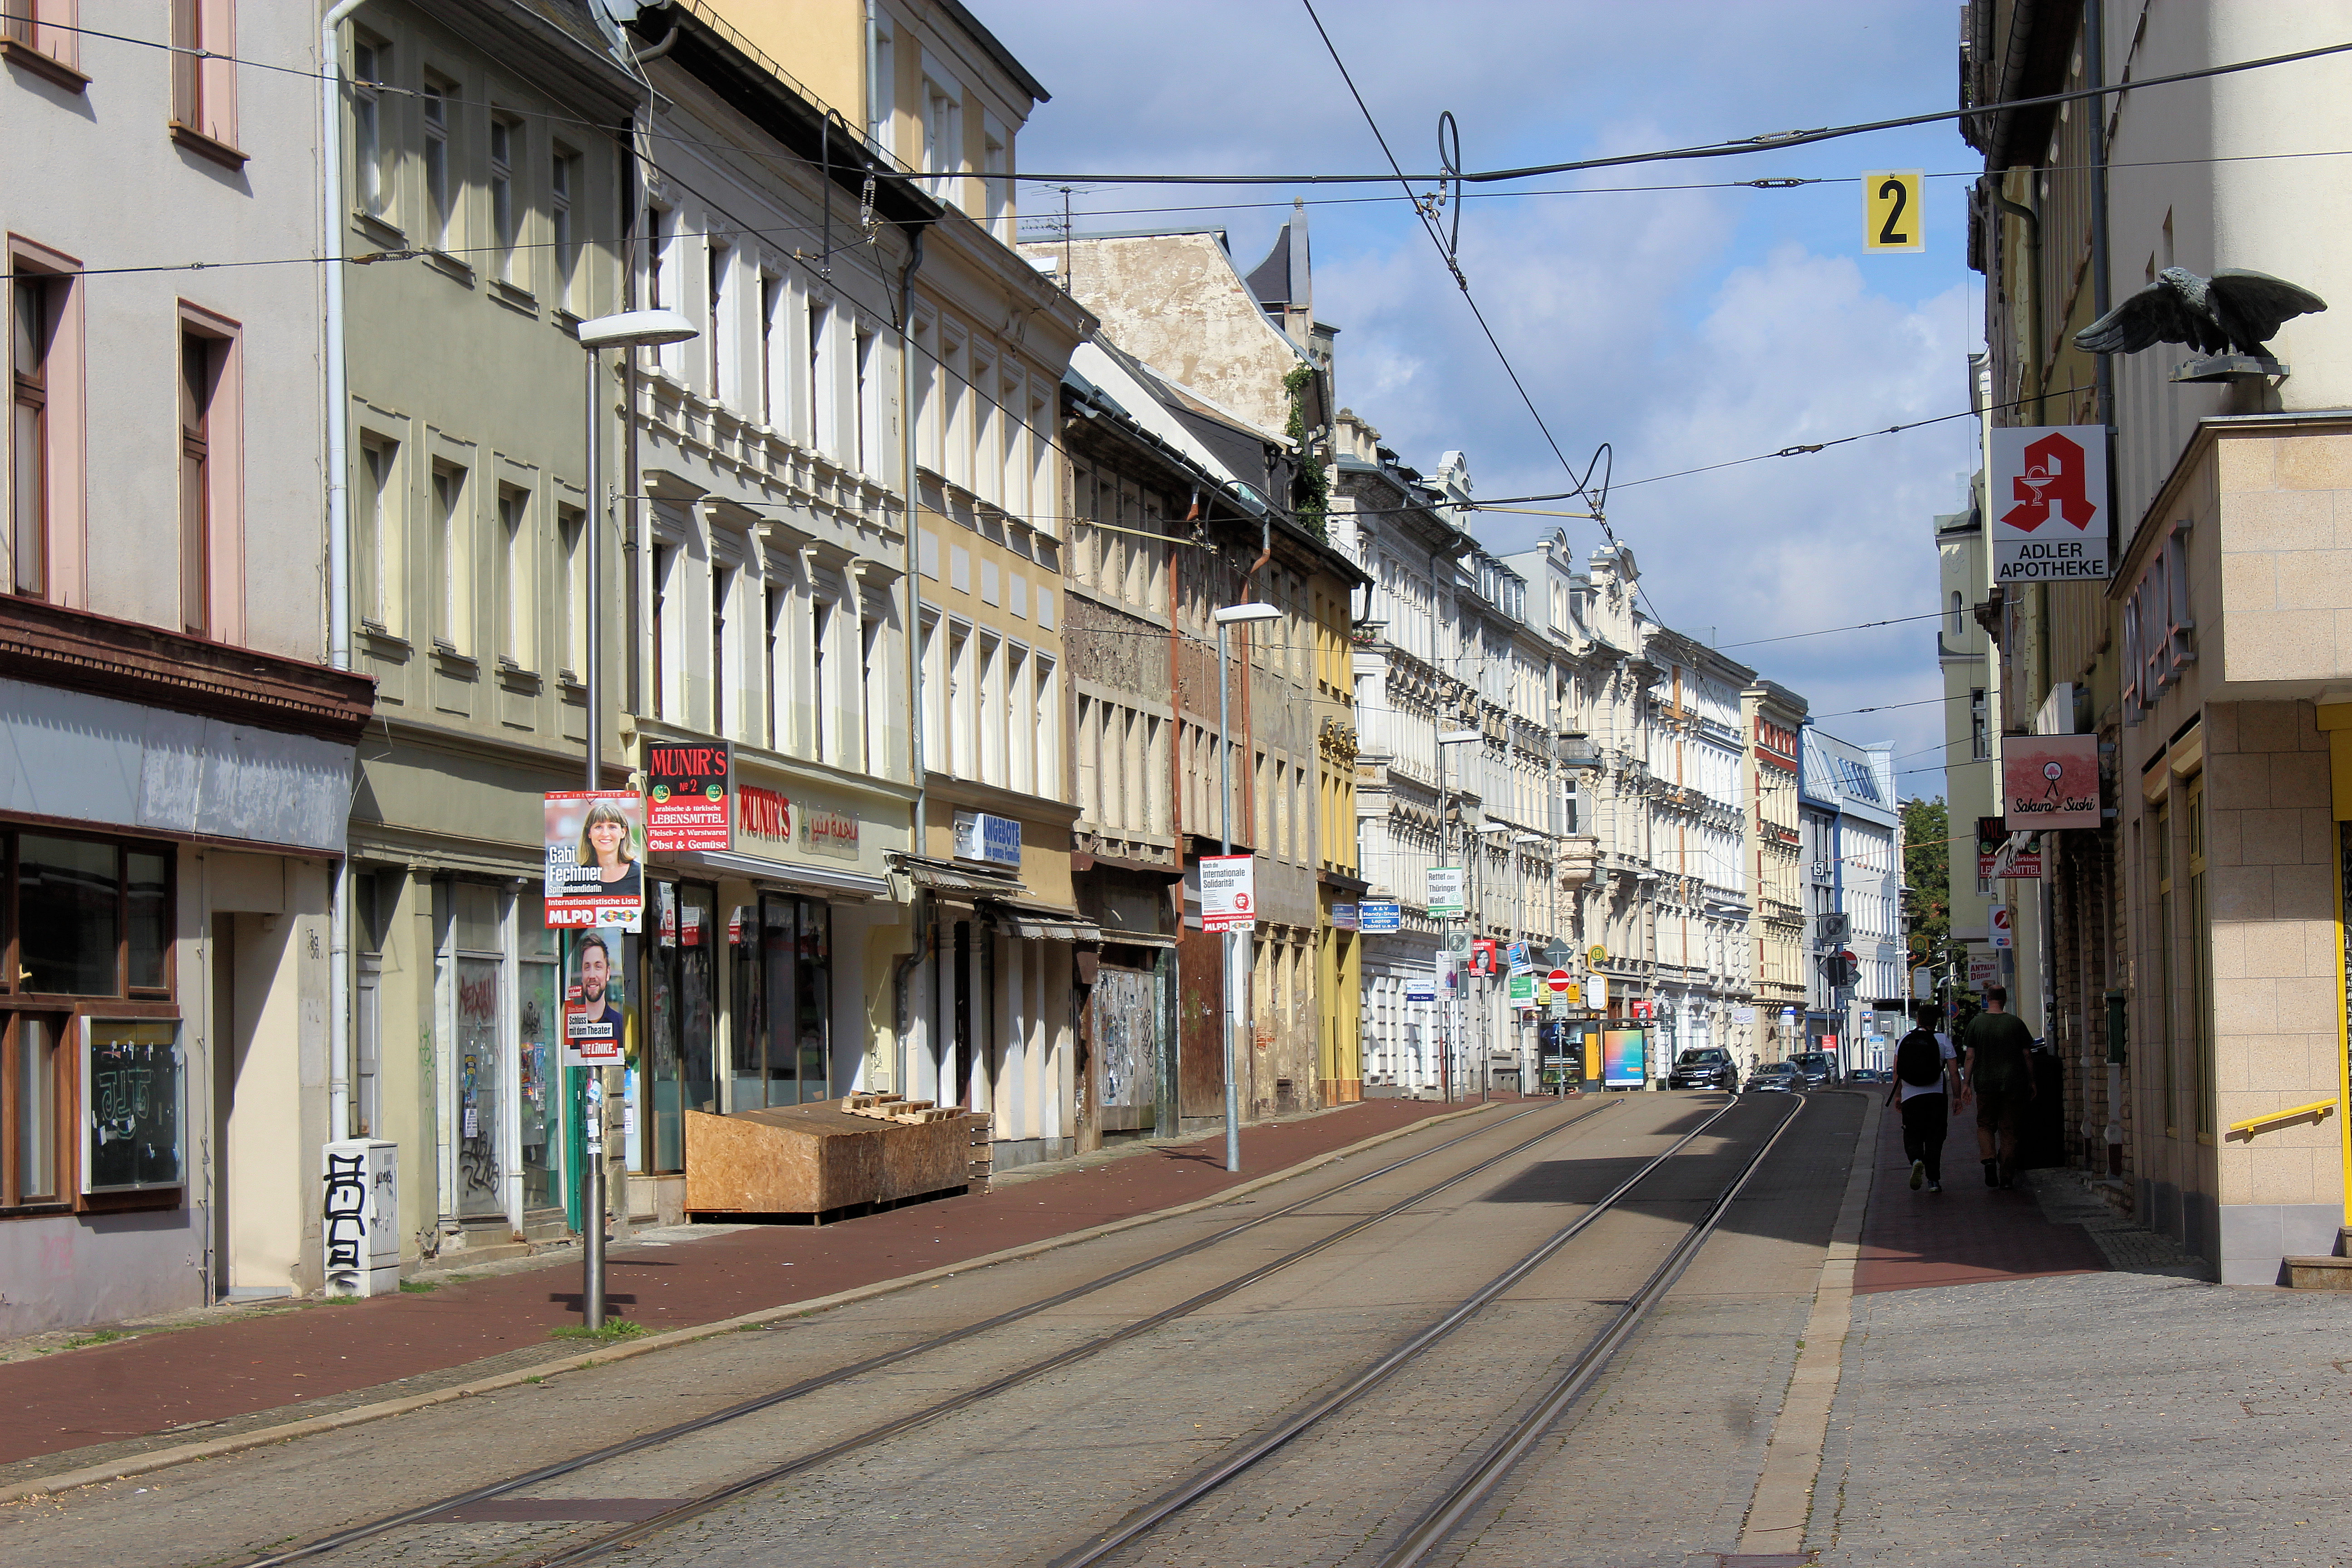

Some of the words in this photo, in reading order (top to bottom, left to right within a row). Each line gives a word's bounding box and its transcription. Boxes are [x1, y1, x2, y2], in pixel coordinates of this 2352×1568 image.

[1879, 179, 1907, 243] 2
[2019, 543, 2082, 560] ADLER
[1999, 560, 2104, 578] APOTHEKE
[691, 779, 698, 792] 2
[2014, 798, 2054, 813] Sakura
[2064, 797, 2095, 812] Sushi
[652, 813, 725, 824] LEBENSMITTEL
[650, 840, 673, 850] Obst
[676, 840, 685, 849] &
[688, 839, 727, 849] Gemüse
[549, 846, 575, 863] Gabi
[549, 864, 602, 882] Fechtner
[1203, 868, 1245, 878] internationale
[1816, 862, 1822, 874] 5
[549, 884, 602, 894] Spitzenkandidatin
[1203, 879, 1234, 888] Solidarität
[1429, 884, 1456, 892] Thüringer
[549, 910, 593, 924] MLPD
[1205, 922, 1229, 931] MLPD
[1971, 972, 1991, 981] Döner
[569, 1016, 586, 1024] Schluss
[588, 1026, 611, 1035] Theater
